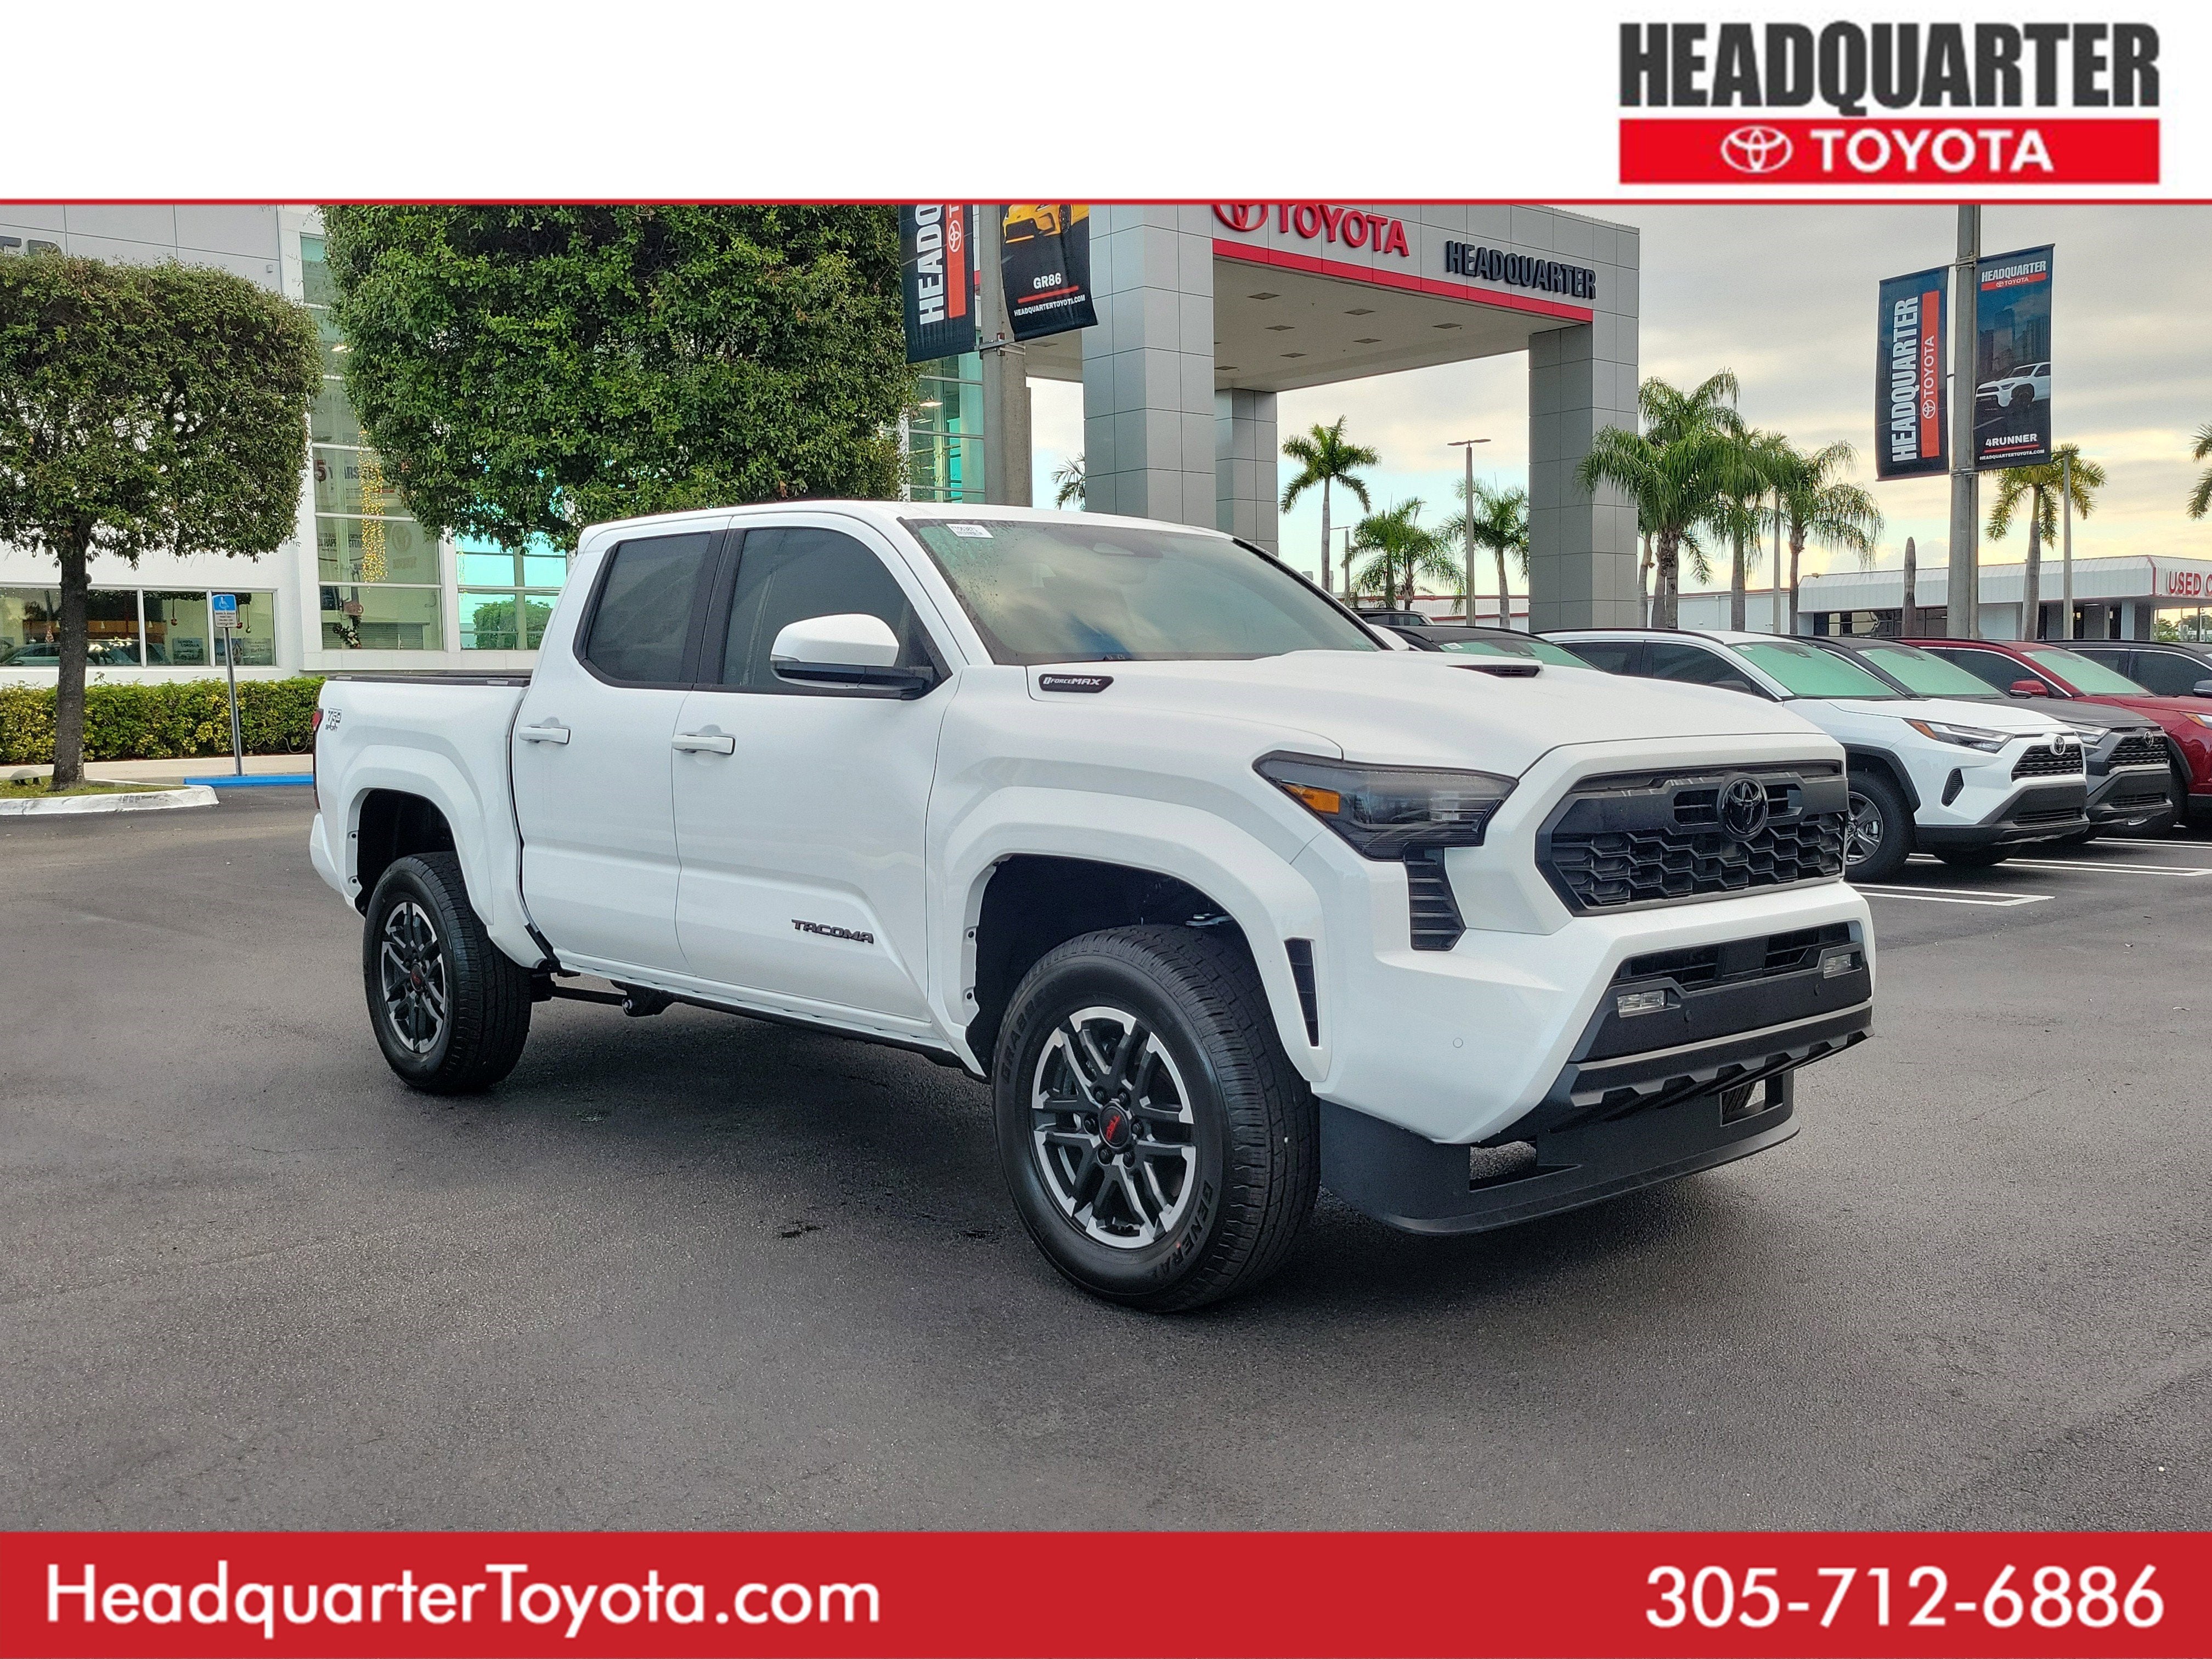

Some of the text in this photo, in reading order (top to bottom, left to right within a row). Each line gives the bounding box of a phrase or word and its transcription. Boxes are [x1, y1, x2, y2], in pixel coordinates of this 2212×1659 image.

[1034, 273, 1062, 289] GR86
[1446, 240, 1596, 300] HEADQUARTER
[1981, 261, 2047, 283] HEADQUARTER
[2005, 277, 2029, 286] TOYOTA
[1014, 295, 1086, 317] HEADQUARTERTOYOTA.COM
[1923, 335, 1934, 399] TOYOTA
[1892, 296, 1920, 462] HEADQUARTER
[1985, 433, 2038, 447] 4RUNNER
[1979, 449, 2045, 460] HEADQUARTERTOYOTA.COM
[2169, 571, 2202, 595] USED
[792, 919, 874, 944] TACOMA
